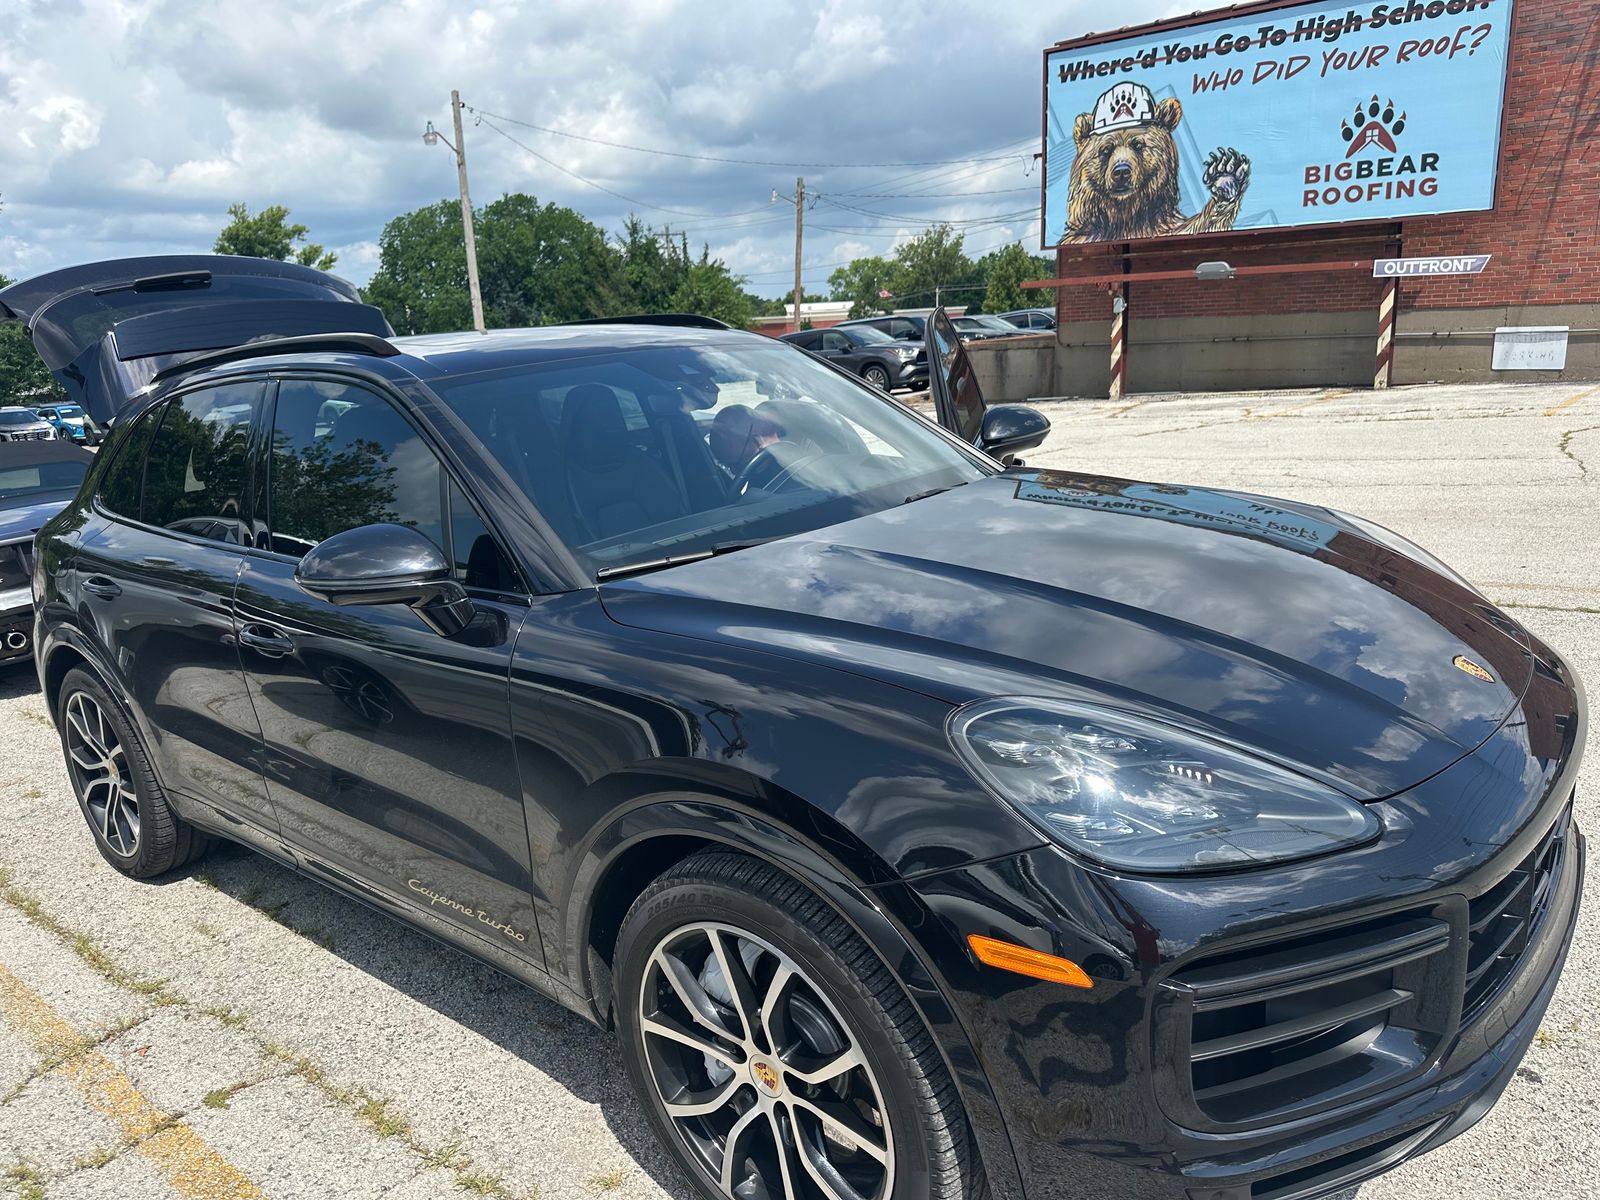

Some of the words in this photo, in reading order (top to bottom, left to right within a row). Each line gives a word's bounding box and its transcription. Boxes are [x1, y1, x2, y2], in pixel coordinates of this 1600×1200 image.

[1059, 47, 1158, 83] Where'd
[1163, 42, 1209, 65] You
[1214, 33, 1250, 56] Go
[1257, 25, 1287, 49] To
[1292, 10, 1363, 43] High
[1192, 66, 1244, 95] WHO
[1252, 55, 1311, 85] DID
[1320, 45, 1389, 78] YOUR
[1396, 23, 1492, 65] ROOF?
[1303, 177, 1438, 208] ROOFING
[1384, 258, 1477, 275] OUTFRONT
[408, 878, 475, 918] Cayenne
